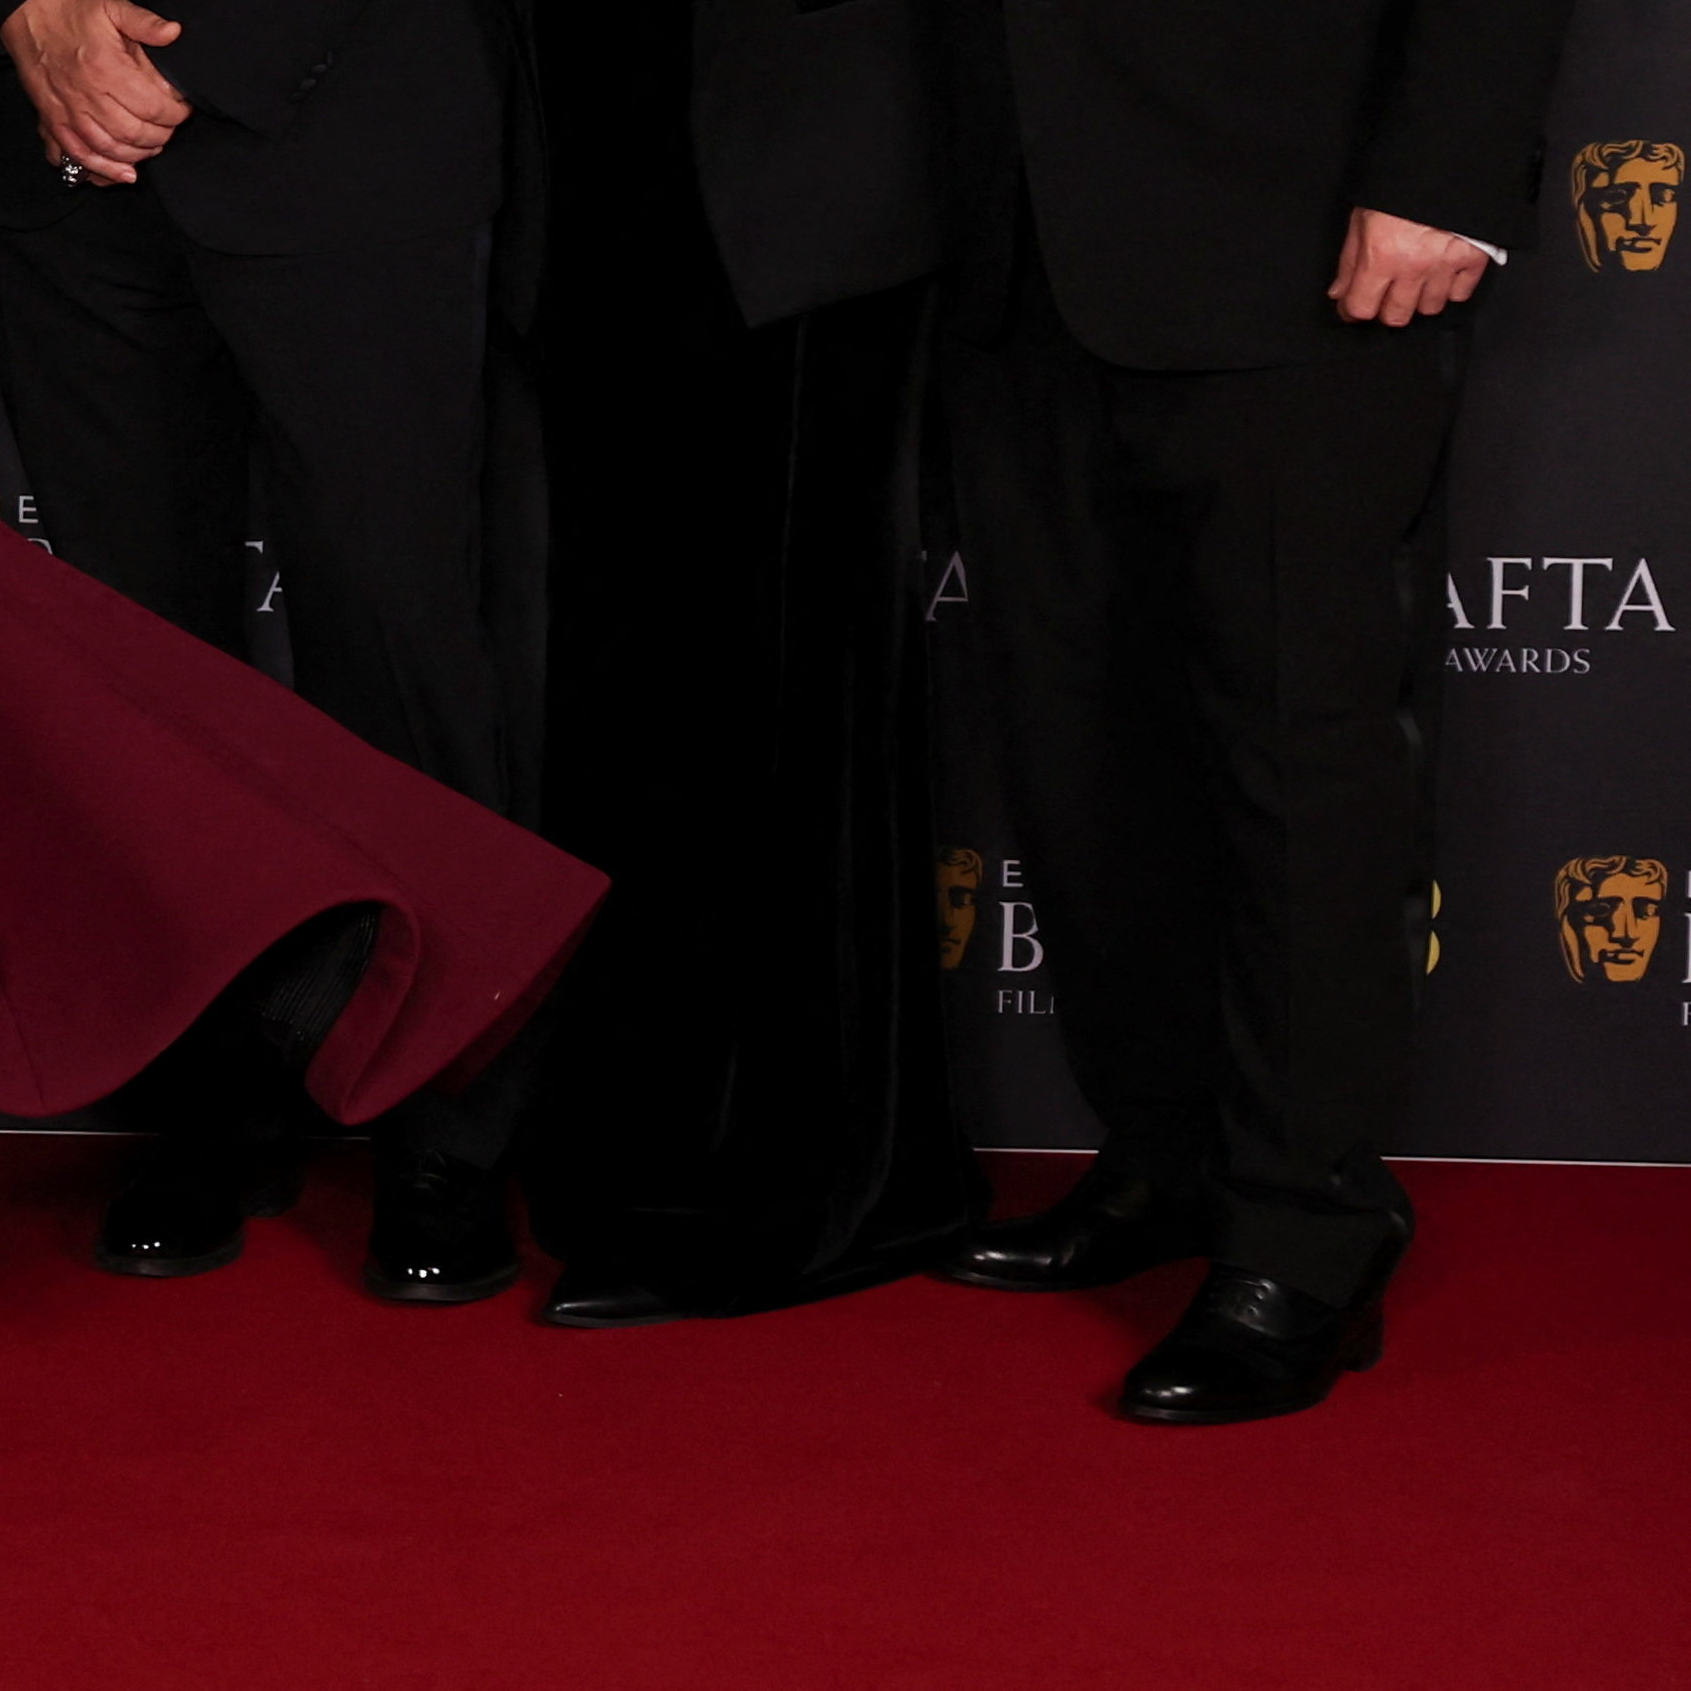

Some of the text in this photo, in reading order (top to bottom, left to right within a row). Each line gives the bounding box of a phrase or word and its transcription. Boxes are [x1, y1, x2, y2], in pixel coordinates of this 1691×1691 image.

[18, 495, 39, 524] E
[1447, 556, 1676, 632] FTA
[1445, 647, 1591, 674] AWARDS
[1002, 859, 1024, 888] E
